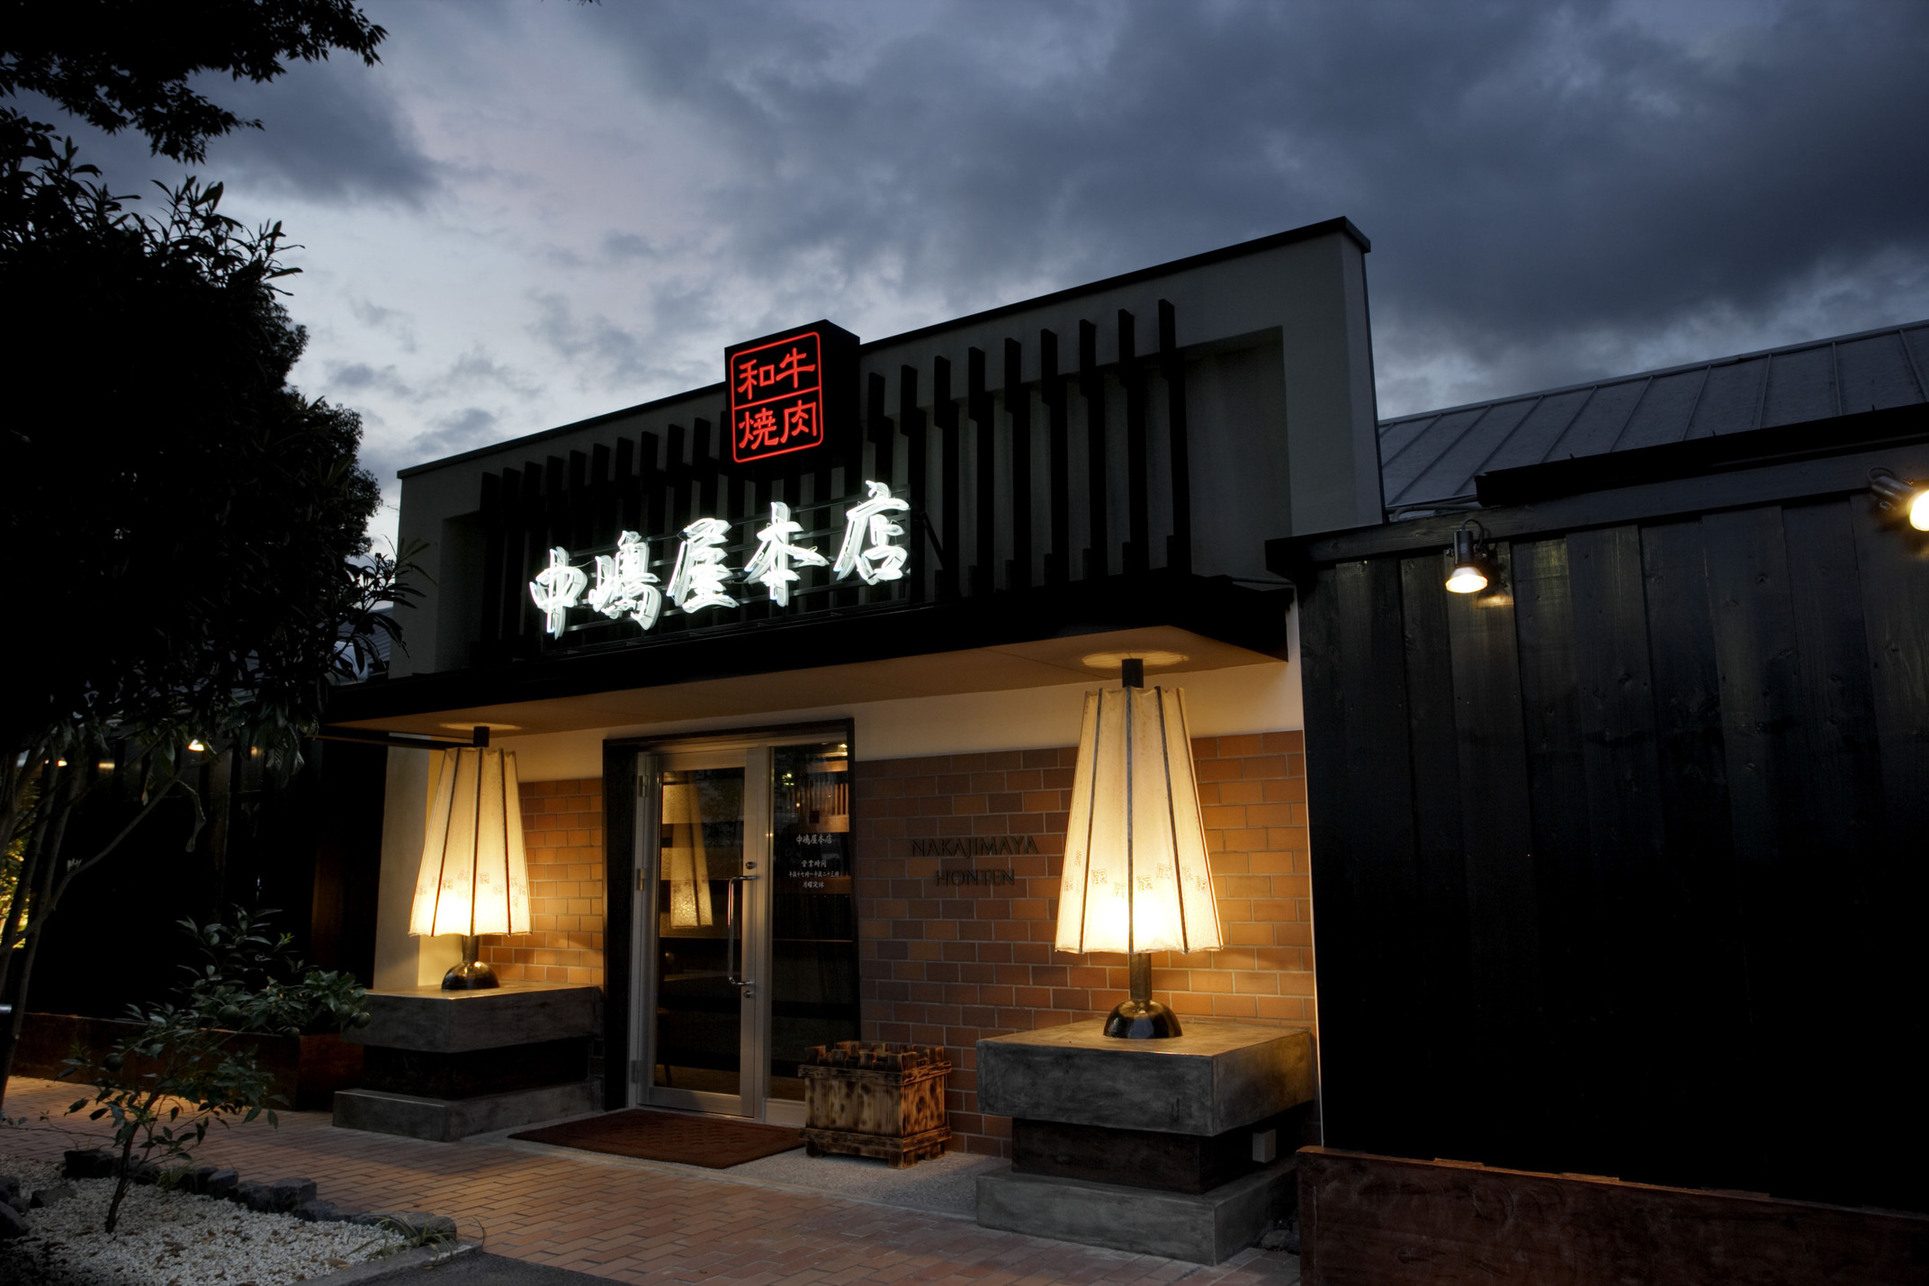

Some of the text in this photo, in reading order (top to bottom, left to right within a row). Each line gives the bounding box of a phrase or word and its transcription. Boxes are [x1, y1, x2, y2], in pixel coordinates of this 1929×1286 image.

[736, 346, 817, 400] 和牛
[737, 399, 818, 451] 焼肉
[529, 480, 911, 640] 中嶋屋本店
[912, 836, 1039, 859] NAKAJIMAYA
[937, 868, 1015, 886] HONTEN
